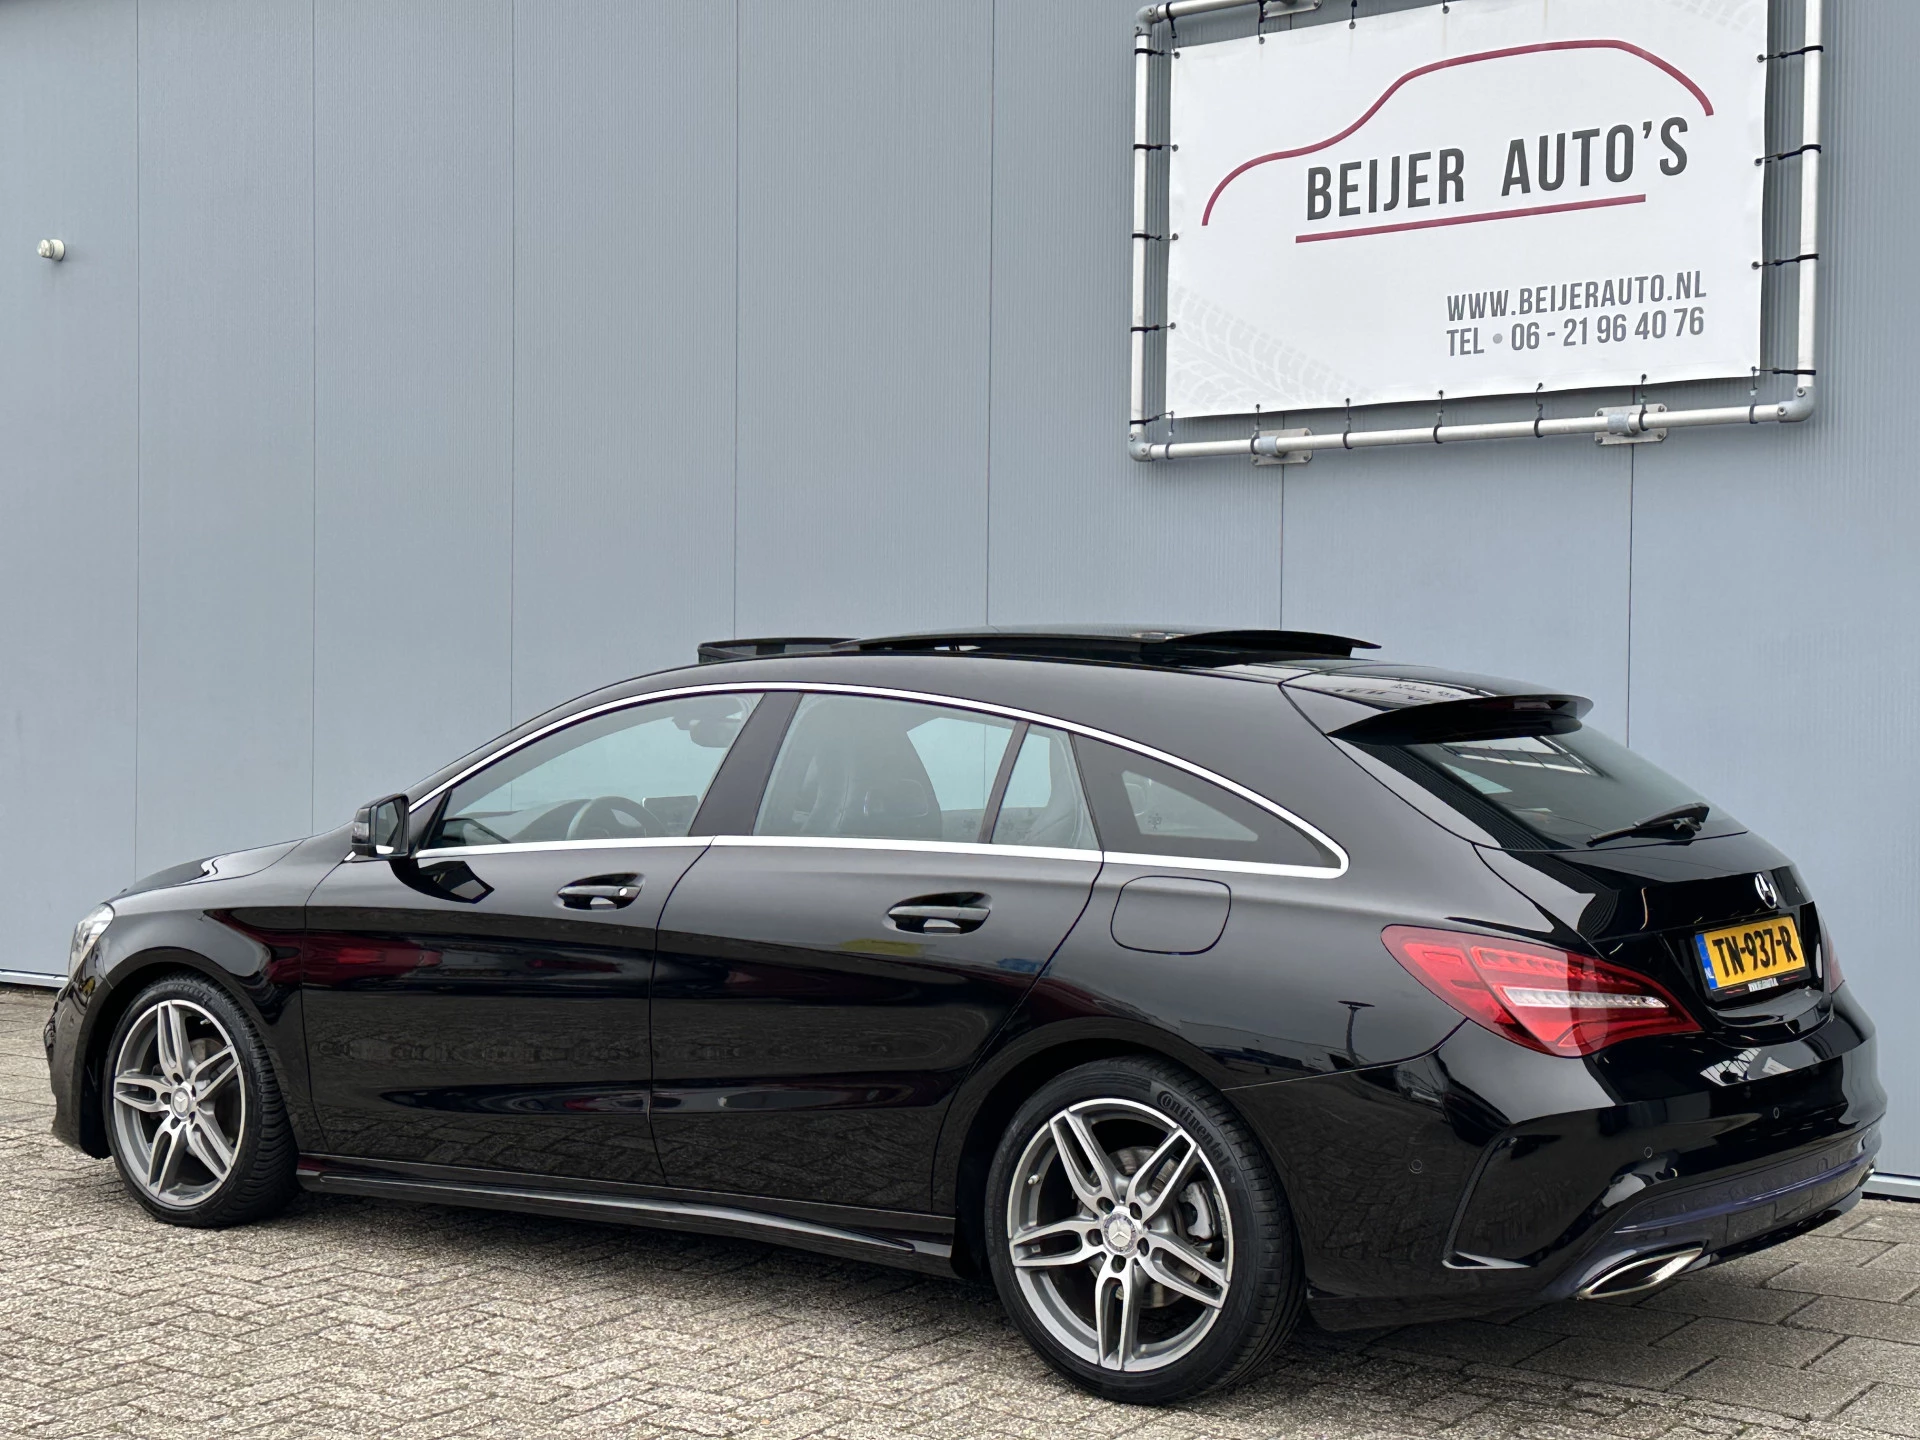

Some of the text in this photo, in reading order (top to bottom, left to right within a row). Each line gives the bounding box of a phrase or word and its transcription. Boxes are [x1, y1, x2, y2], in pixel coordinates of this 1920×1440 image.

[1307, 116, 1689, 220] BEIJER AUTO'S
[1447, 270, 1707, 321] WWW.BEIJERAUTO.NL
[1446, 327, 1485, 356] TEL
[1511, 321, 1540, 351] 06
[1563, 317, 1587, 346] 21
[1596, 313, 1627, 344] 96
[1634, 310, 1666, 340] 40
[1673, 306, 1705, 337] 76
[1712, 925, 1797, 978] TN-937-R
[1157, 1091, 1230, 1166] Continental
